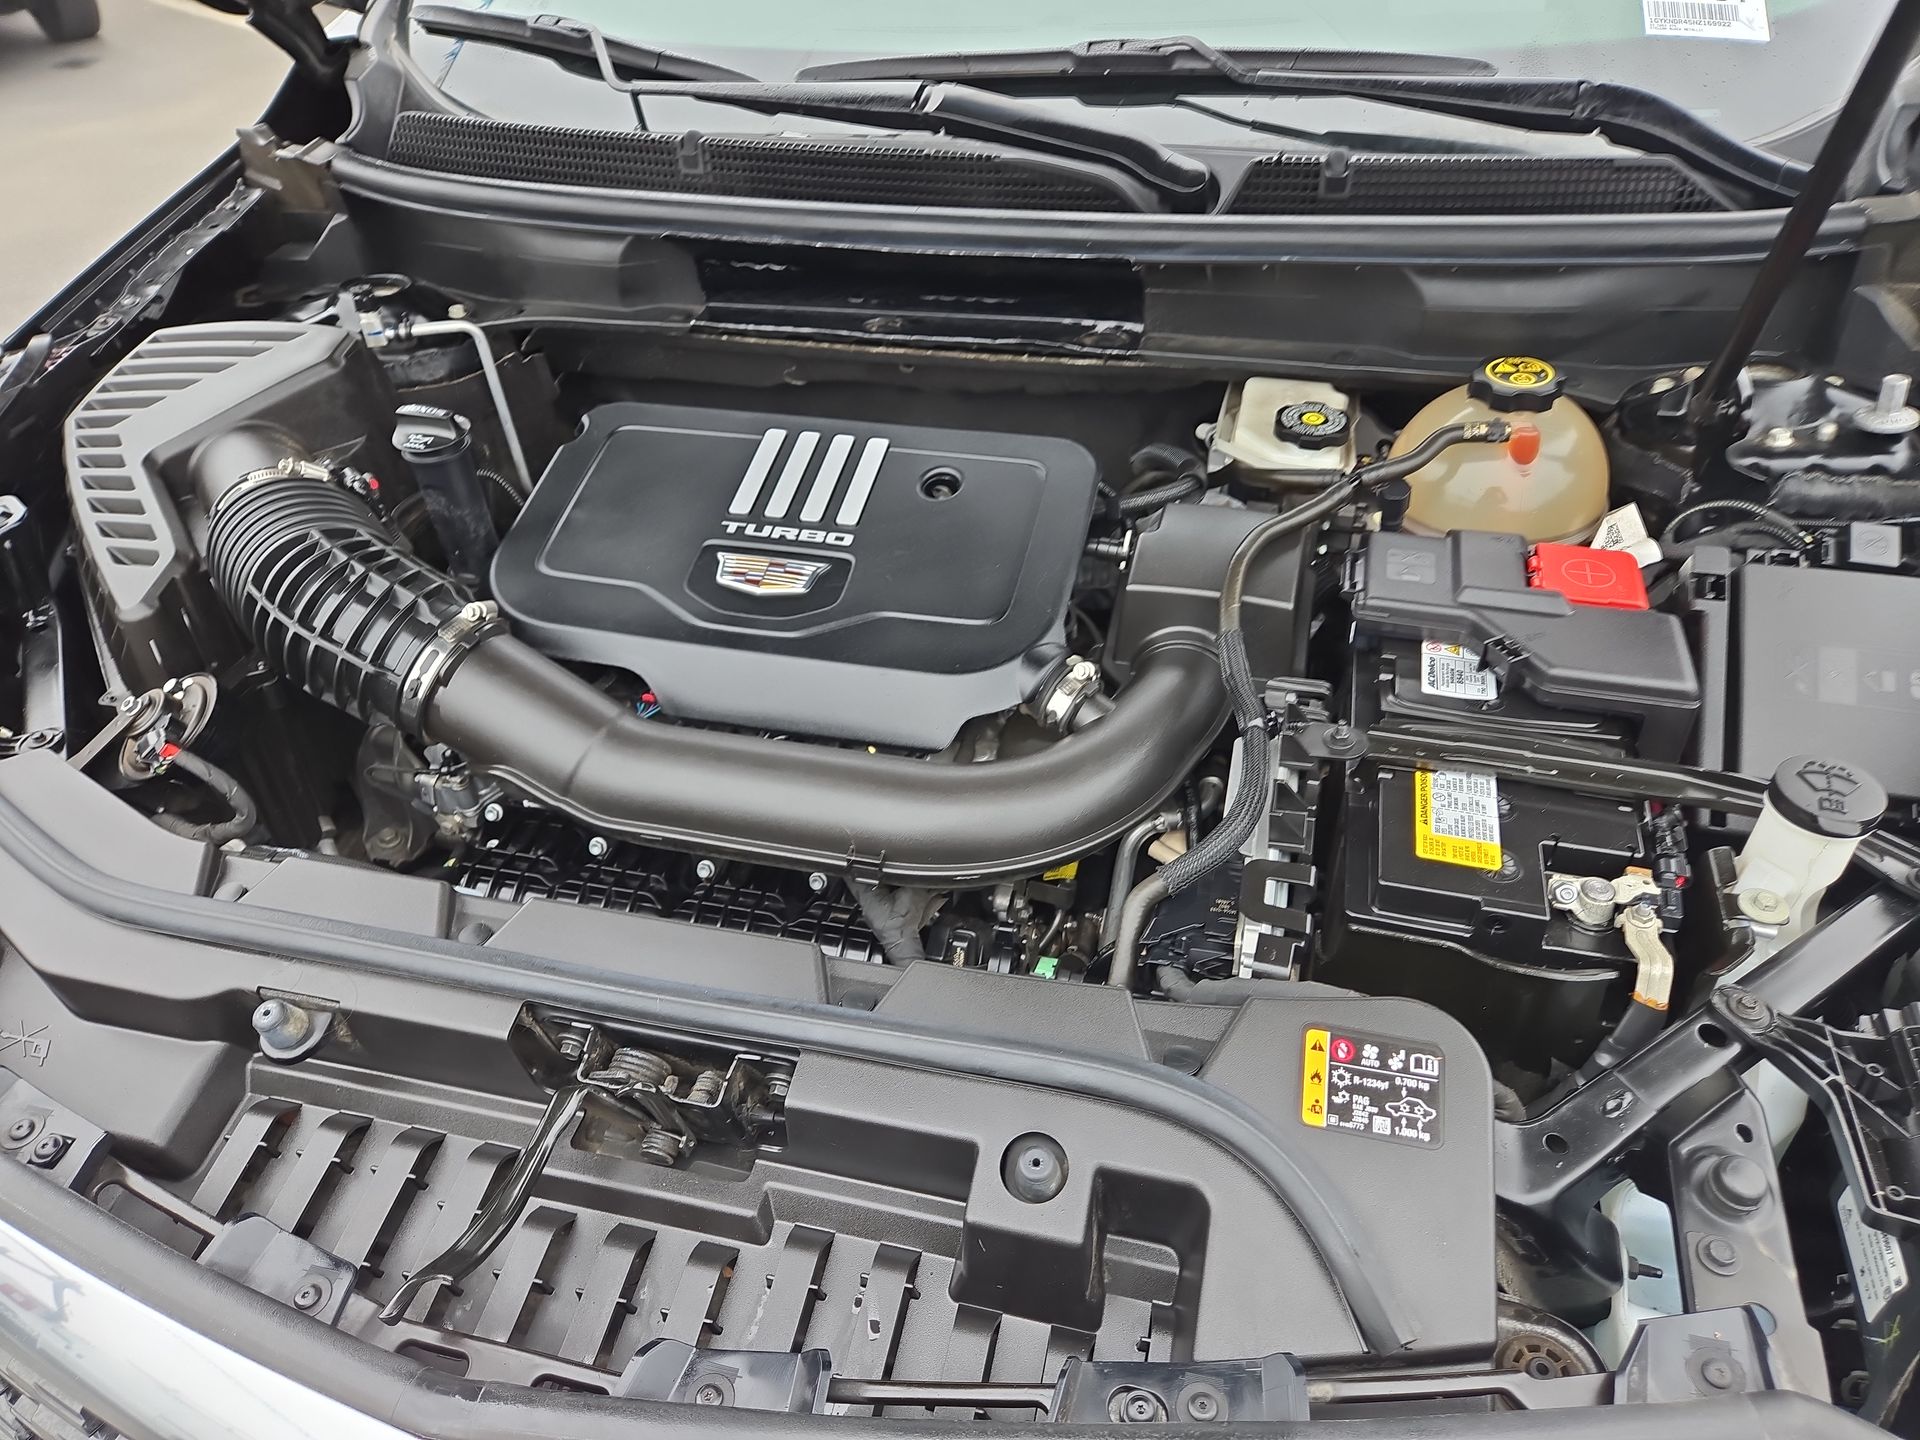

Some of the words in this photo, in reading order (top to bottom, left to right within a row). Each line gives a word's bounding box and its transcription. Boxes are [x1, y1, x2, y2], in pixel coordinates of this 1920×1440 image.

[721, 520, 855, 547] TURBO
[1427, 656, 1436, 689] ACDelco
[1420, 793, 1428, 817] DANGER
[1361, 1058, 1380, 1068] AUTO
[1353, 1076, 1389, 1091] R-1234yf
[1395, 1077, 1418, 1088] 0.700
[1418, 1080, 1430, 1091] kg
[1352, 1094, 1370, 1105] PAG
[1394, 1127, 1417, 1138] 1.000
[1418, 1130, 1431, 1141] kg
